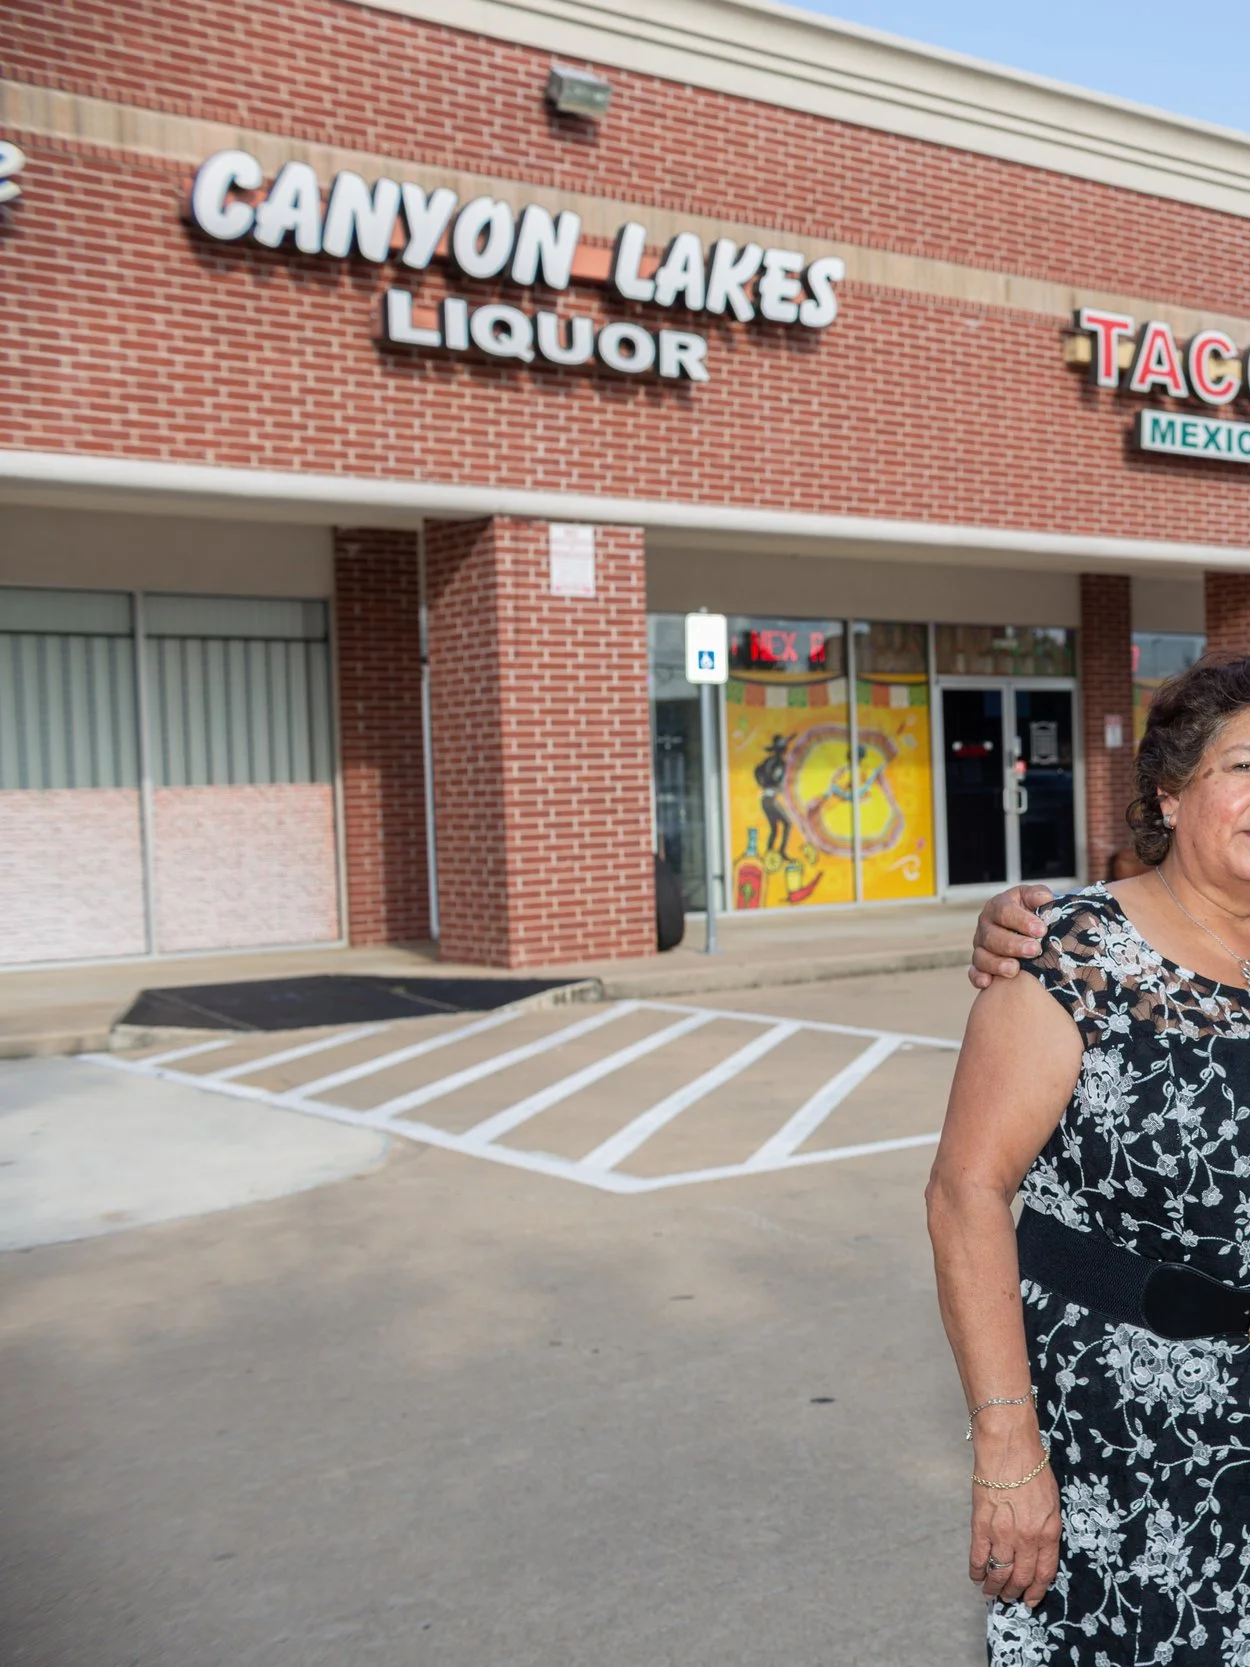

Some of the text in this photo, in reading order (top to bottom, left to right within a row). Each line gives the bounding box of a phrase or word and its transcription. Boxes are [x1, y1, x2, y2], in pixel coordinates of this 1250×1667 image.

[193, 149, 845, 327] CANYON LAKES
[386, 287, 710, 382] LIQUOR
